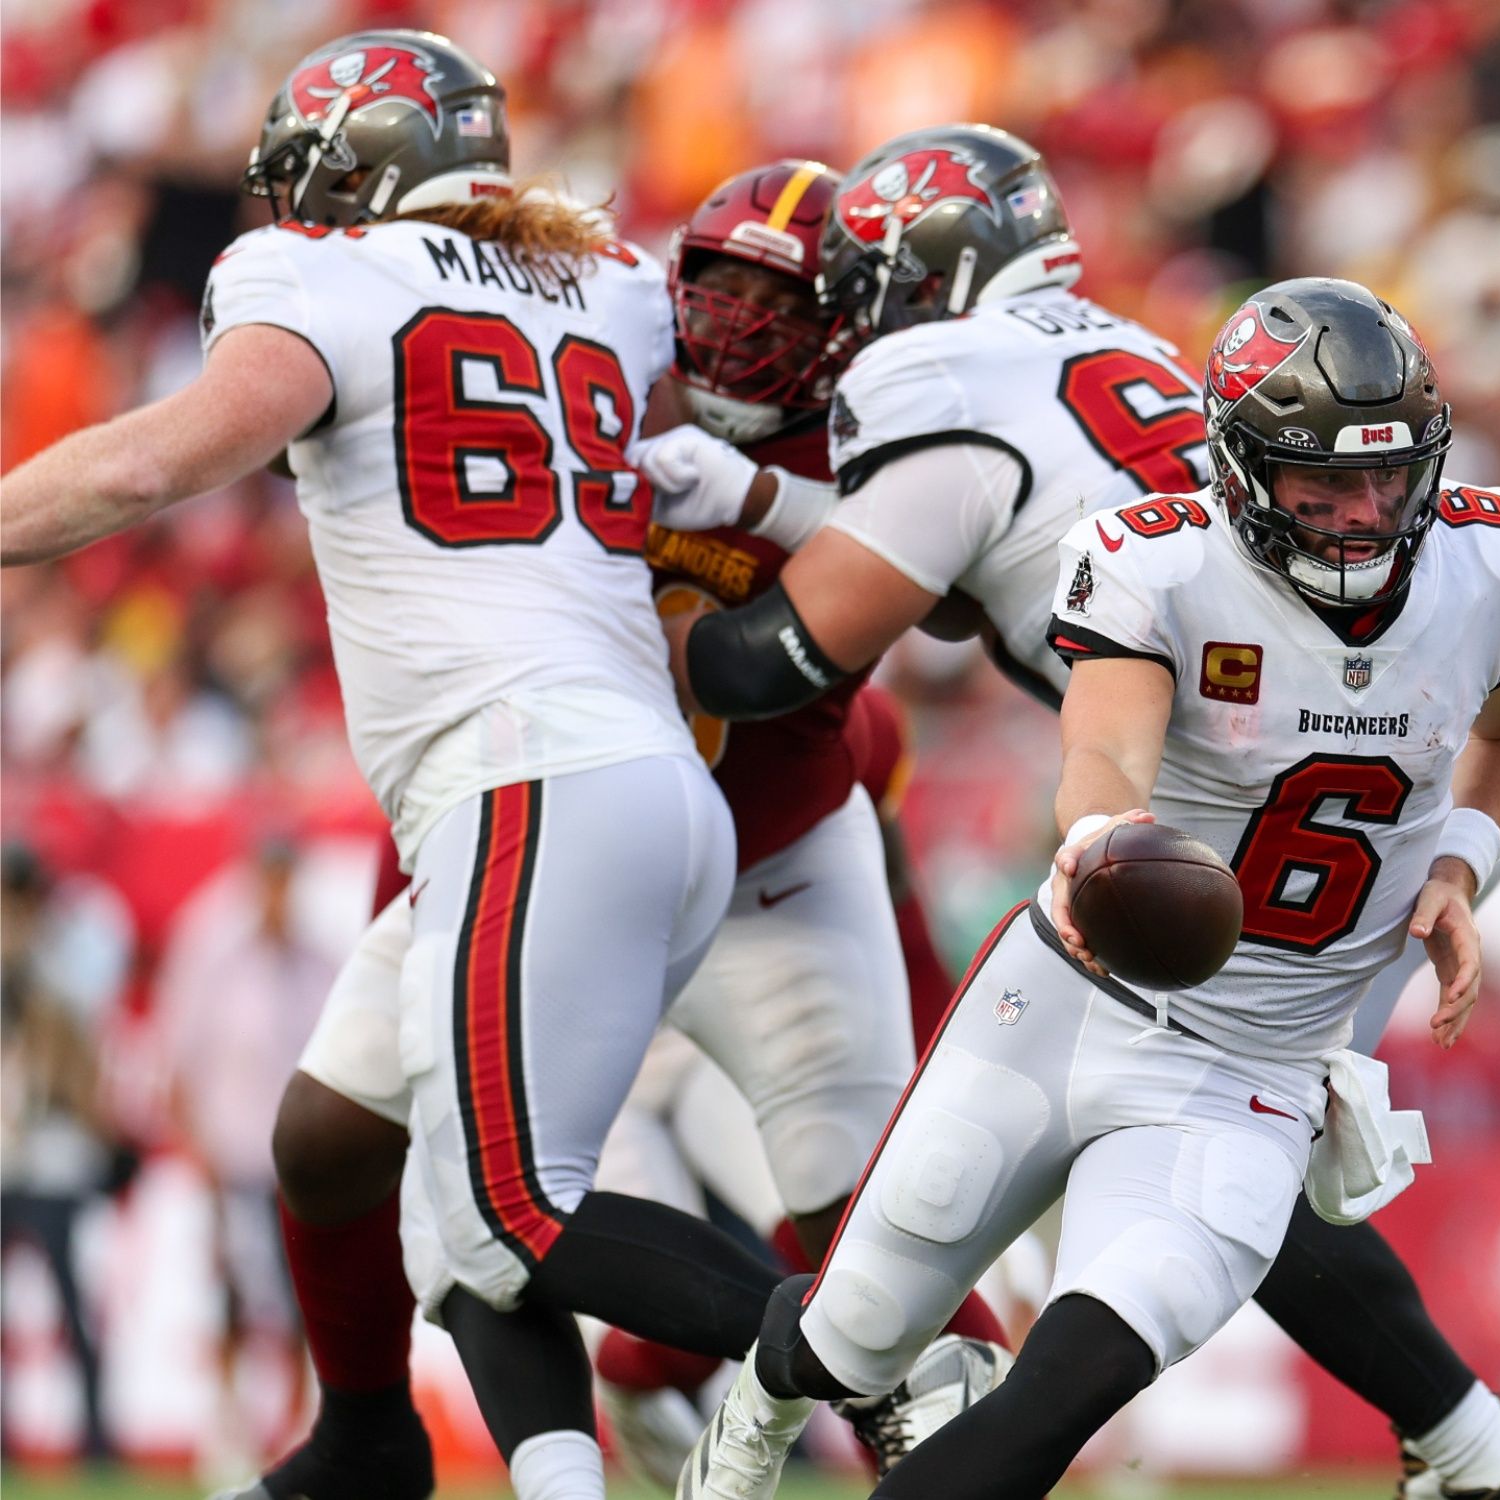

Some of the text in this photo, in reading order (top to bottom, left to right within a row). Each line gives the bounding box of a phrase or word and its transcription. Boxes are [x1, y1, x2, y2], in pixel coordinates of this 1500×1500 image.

[421, 237, 587, 311] MAUCH
[391, 306, 654, 556] 69
[1278, 436, 1316, 448] OAKLEY
[1115, 496, 1212, 539] 6
[1206, 647, 1258, 687] C
[1347, 670, 1369, 686] NFL
[1298, 708, 1409, 740] BUCCANEERS
[1229, 752, 1414, 957] 6
[998, 1000, 1016, 1020] NFL
